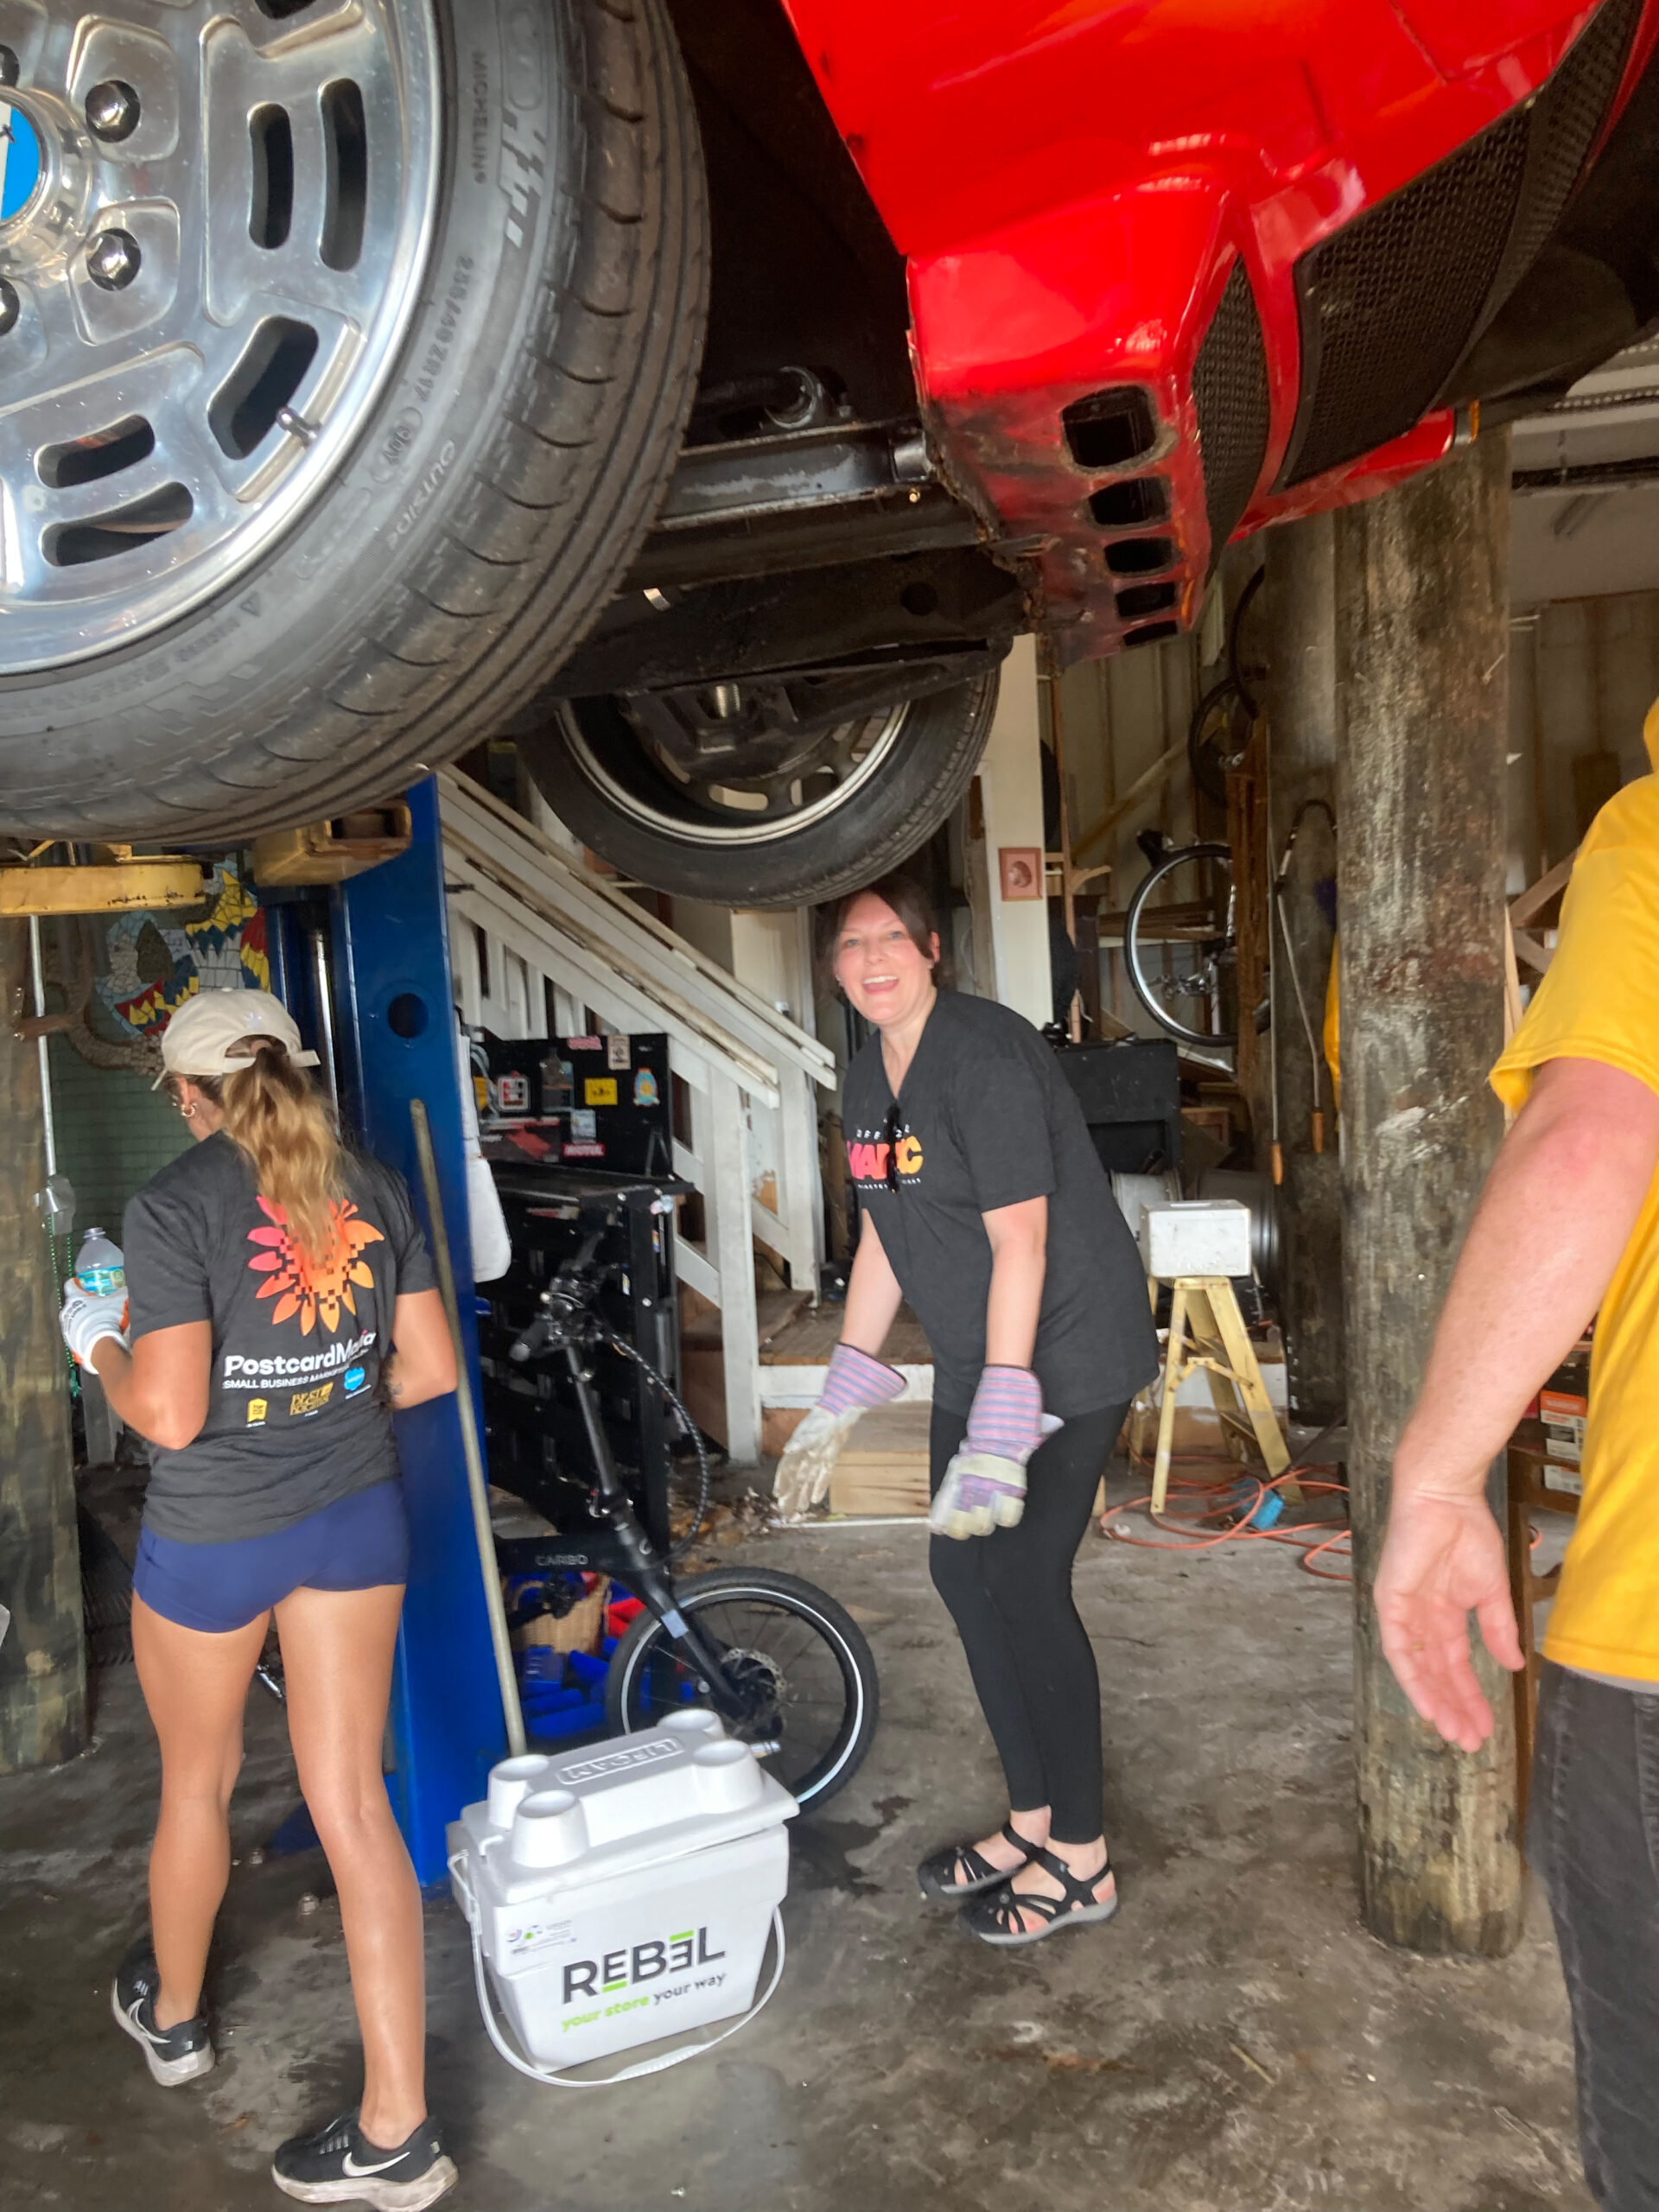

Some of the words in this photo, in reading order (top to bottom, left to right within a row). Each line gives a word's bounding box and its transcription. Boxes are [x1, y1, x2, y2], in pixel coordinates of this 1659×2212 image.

[222, 1379, 259, 1389] SMALL
[260, 1376, 309, 1389] BUSINESS
[563, 1926, 726, 2005] REBEL
[562, 2010, 602, 2032] your
[604, 1996, 650, 2017] store
[652, 1983, 691, 2005] your
[695, 1974, 727, 1989] way
